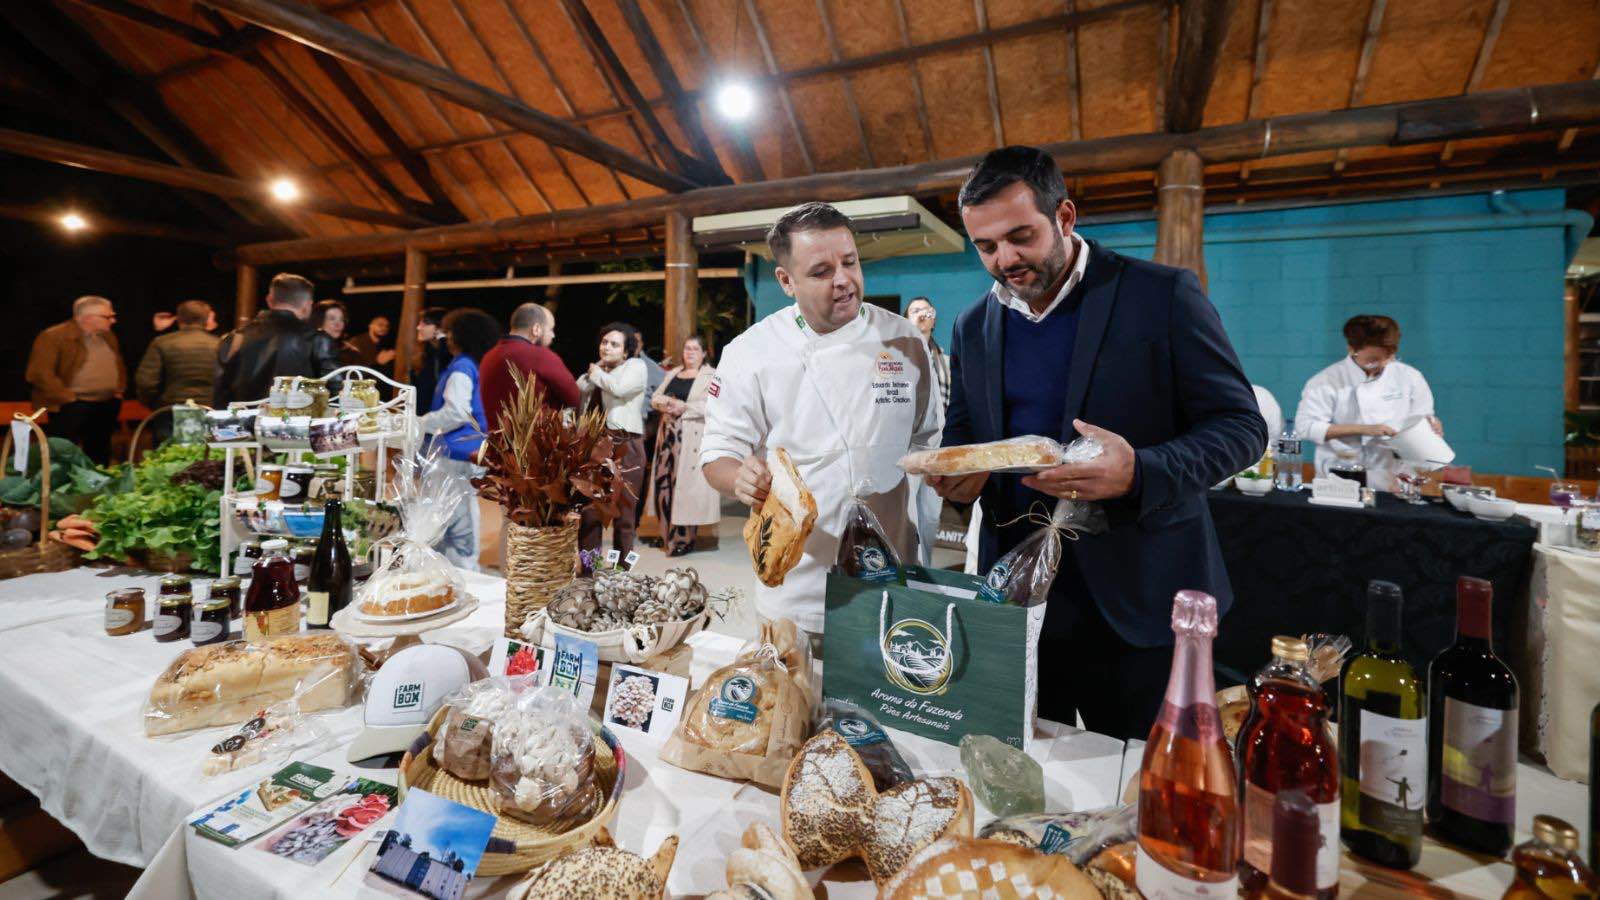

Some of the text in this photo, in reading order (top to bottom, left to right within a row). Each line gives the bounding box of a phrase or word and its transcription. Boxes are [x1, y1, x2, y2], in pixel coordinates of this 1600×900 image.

[397, 691, 420, 704] BOX
[398, 683, 421, 693] FARM
[870, 688, 904, 705] Aroma
[904, 699, 918, 709] da
[918, 700, 963, 720] Fazenda
[879, 703, 951, 730] Pães Artesanais
